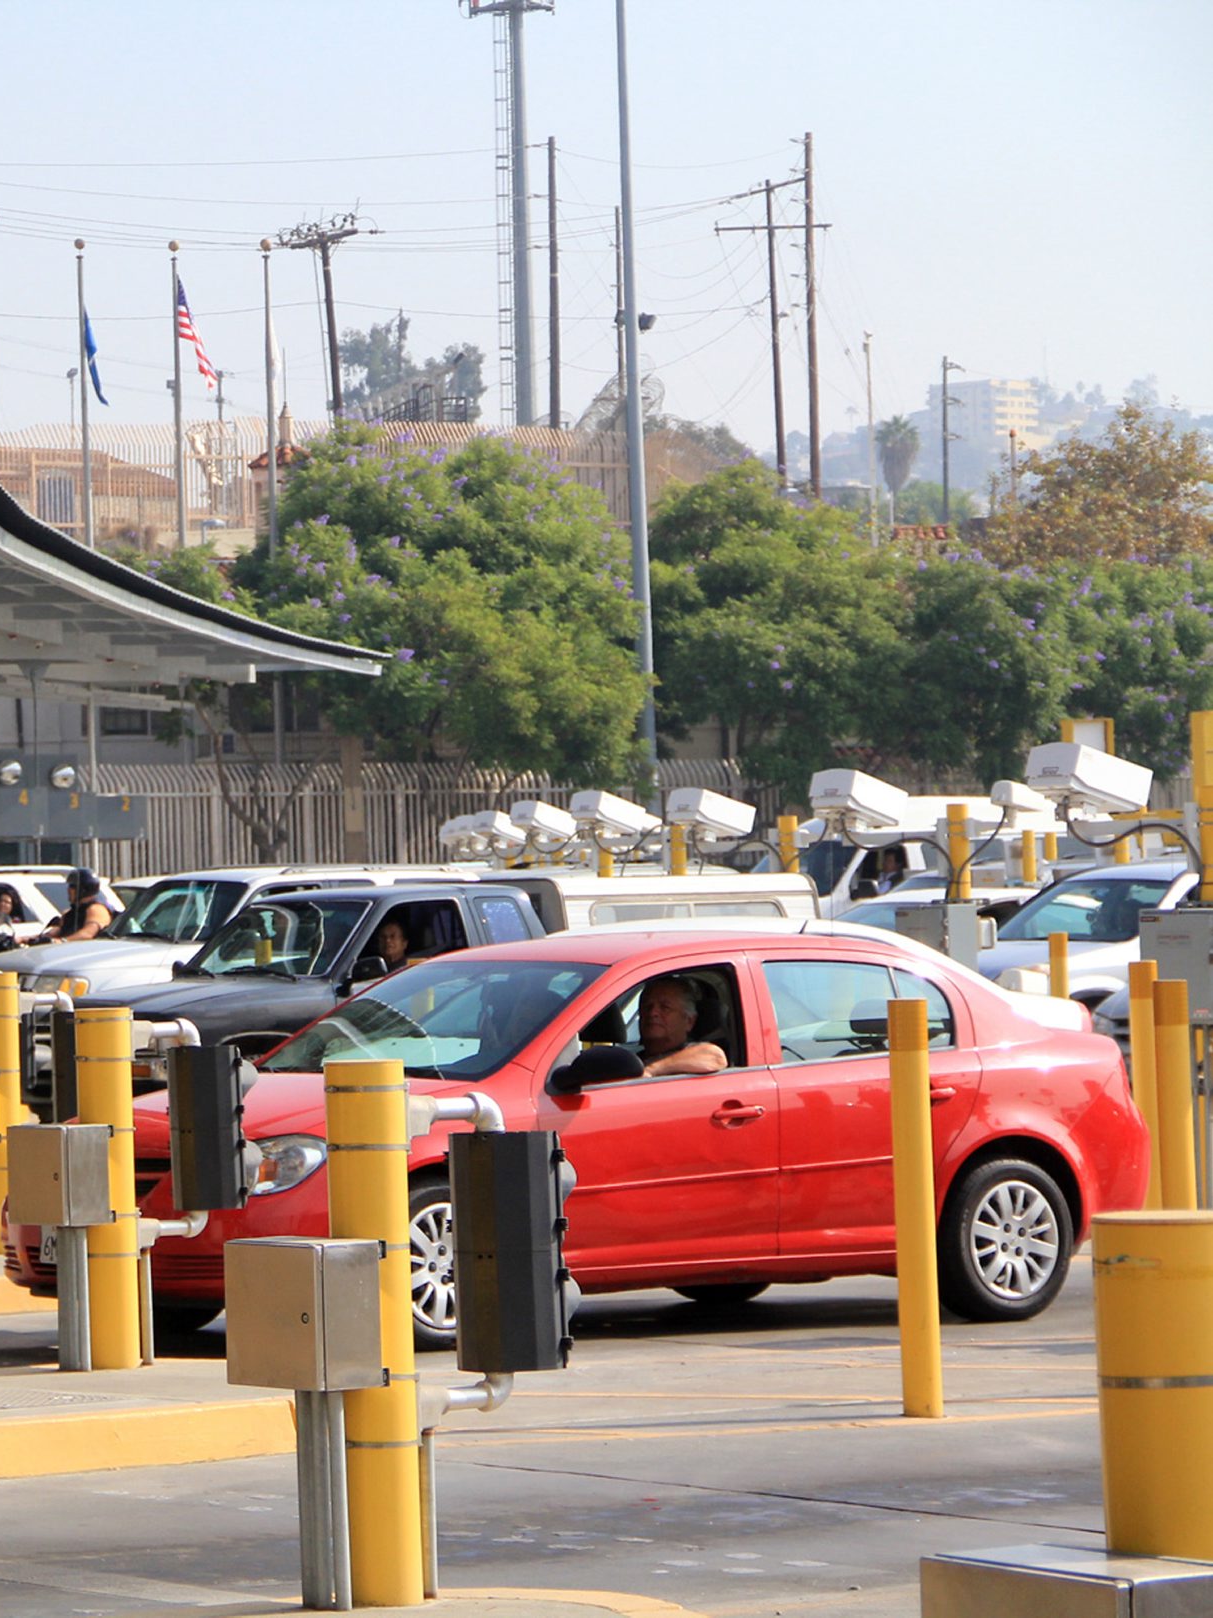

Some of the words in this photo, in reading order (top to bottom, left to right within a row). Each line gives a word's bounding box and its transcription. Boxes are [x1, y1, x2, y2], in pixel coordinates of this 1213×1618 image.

[18, 789, 29, 806] 4
[69, 792, 80, 809] 3
[121, 795, 131, 812] 2
